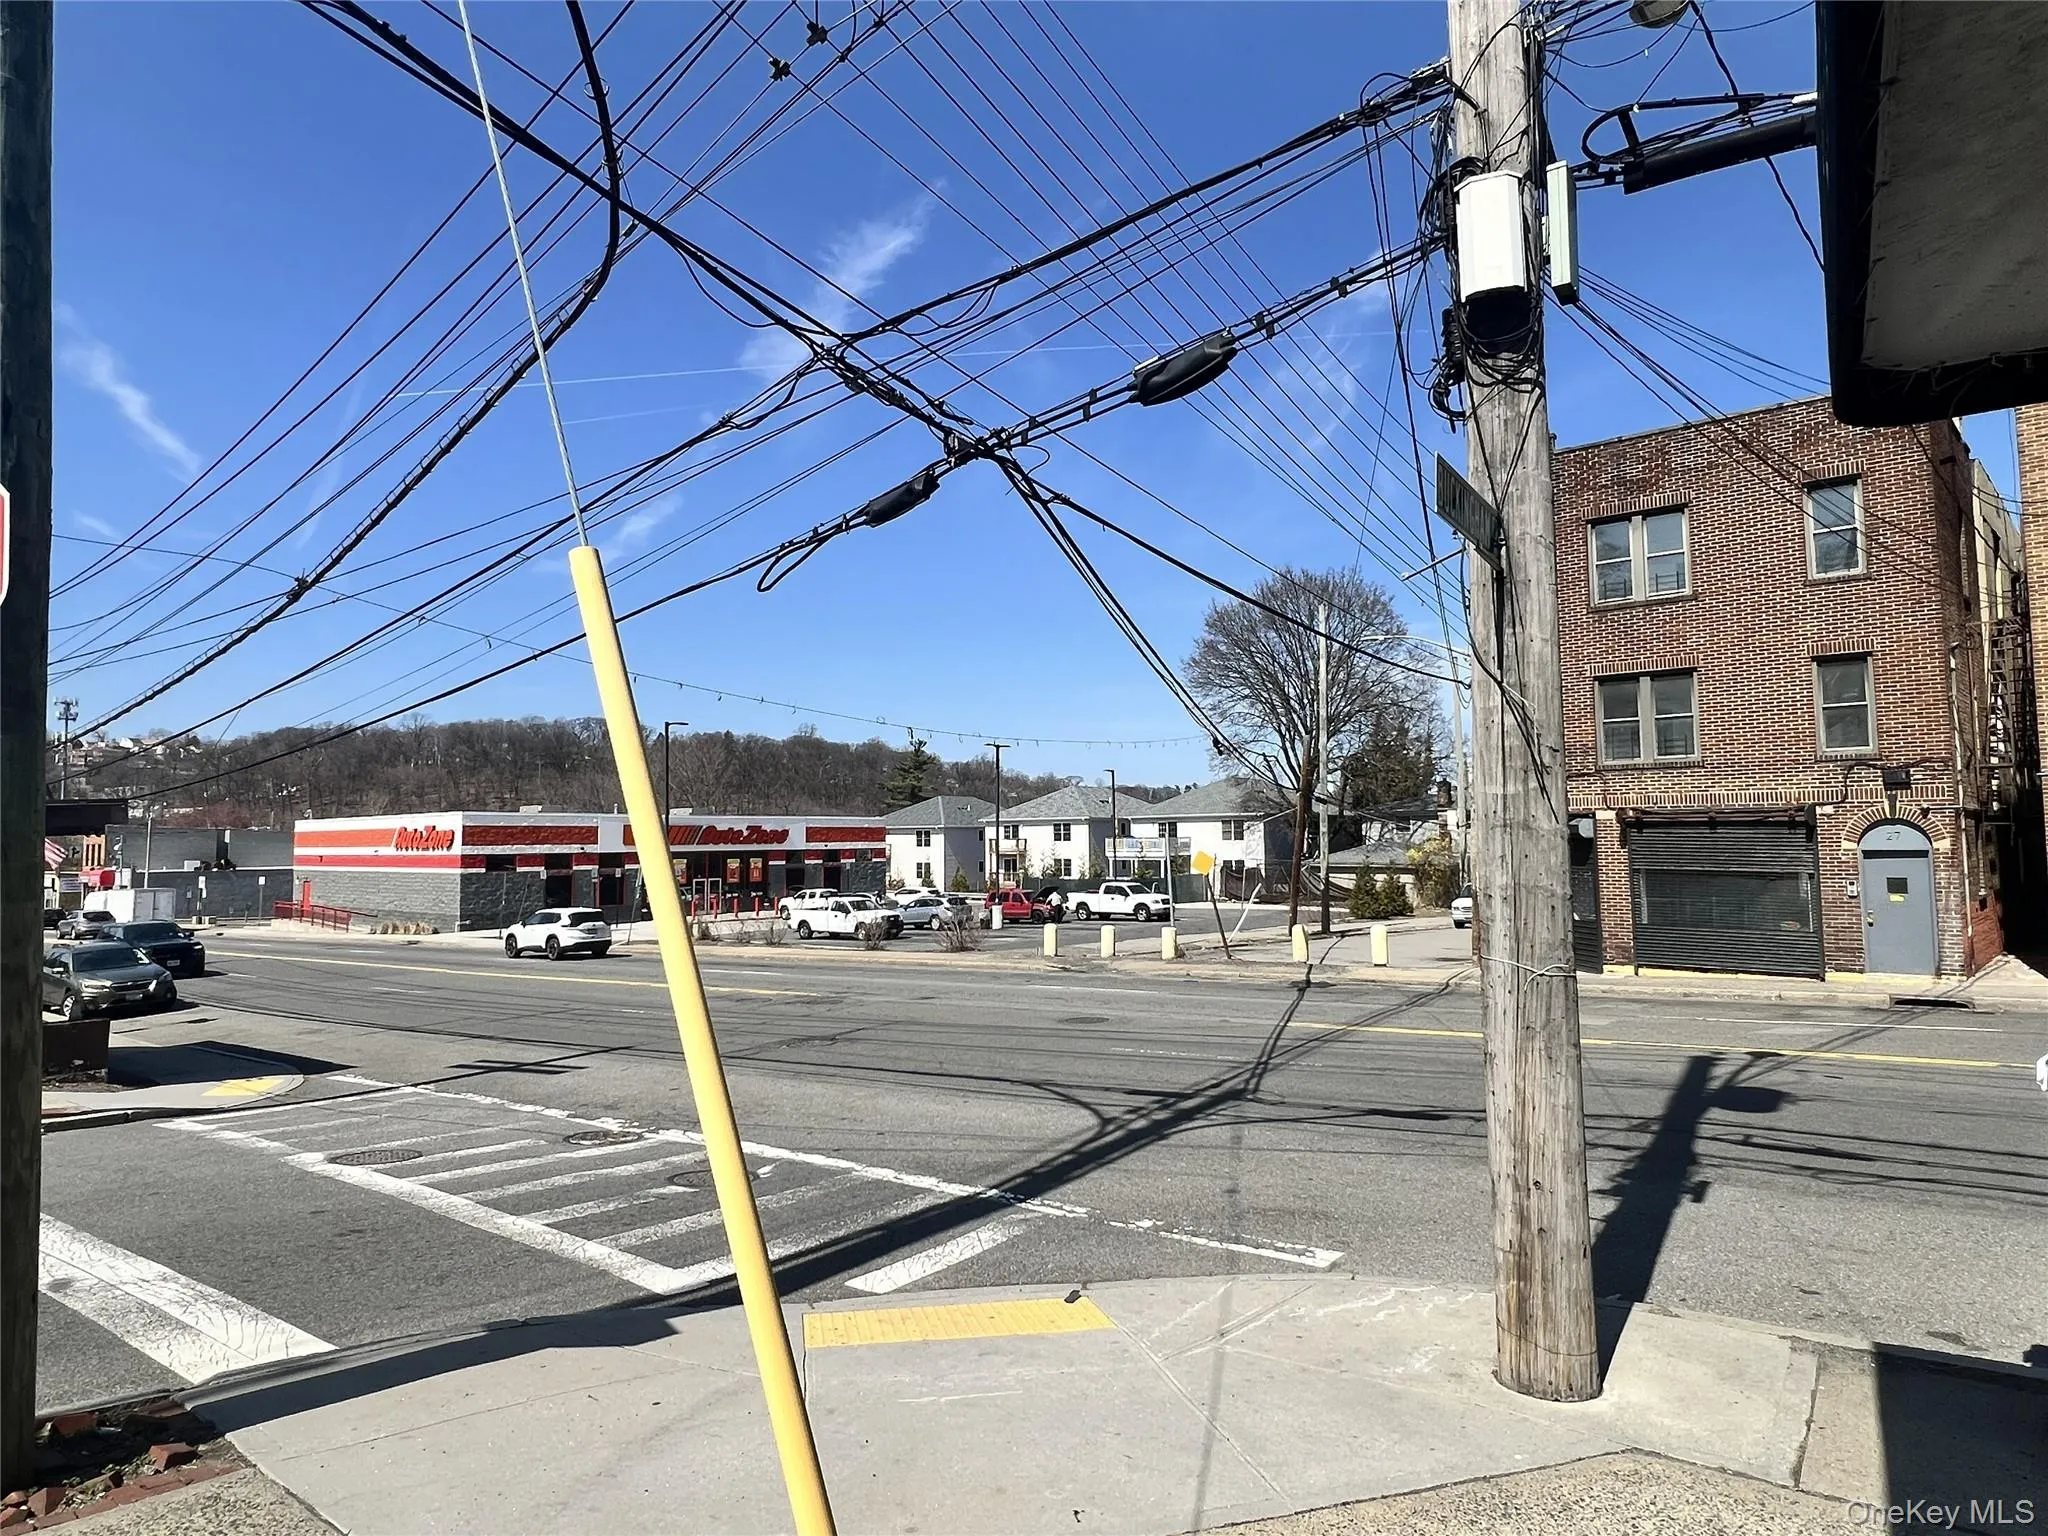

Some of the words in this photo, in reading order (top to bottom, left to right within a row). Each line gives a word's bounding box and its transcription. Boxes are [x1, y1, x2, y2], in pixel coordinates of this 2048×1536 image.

[395, 825, 455, 852] AutoZone
[697, 825, 789, 845] AutoZone
[1886, 831, 1901, 841] 27
